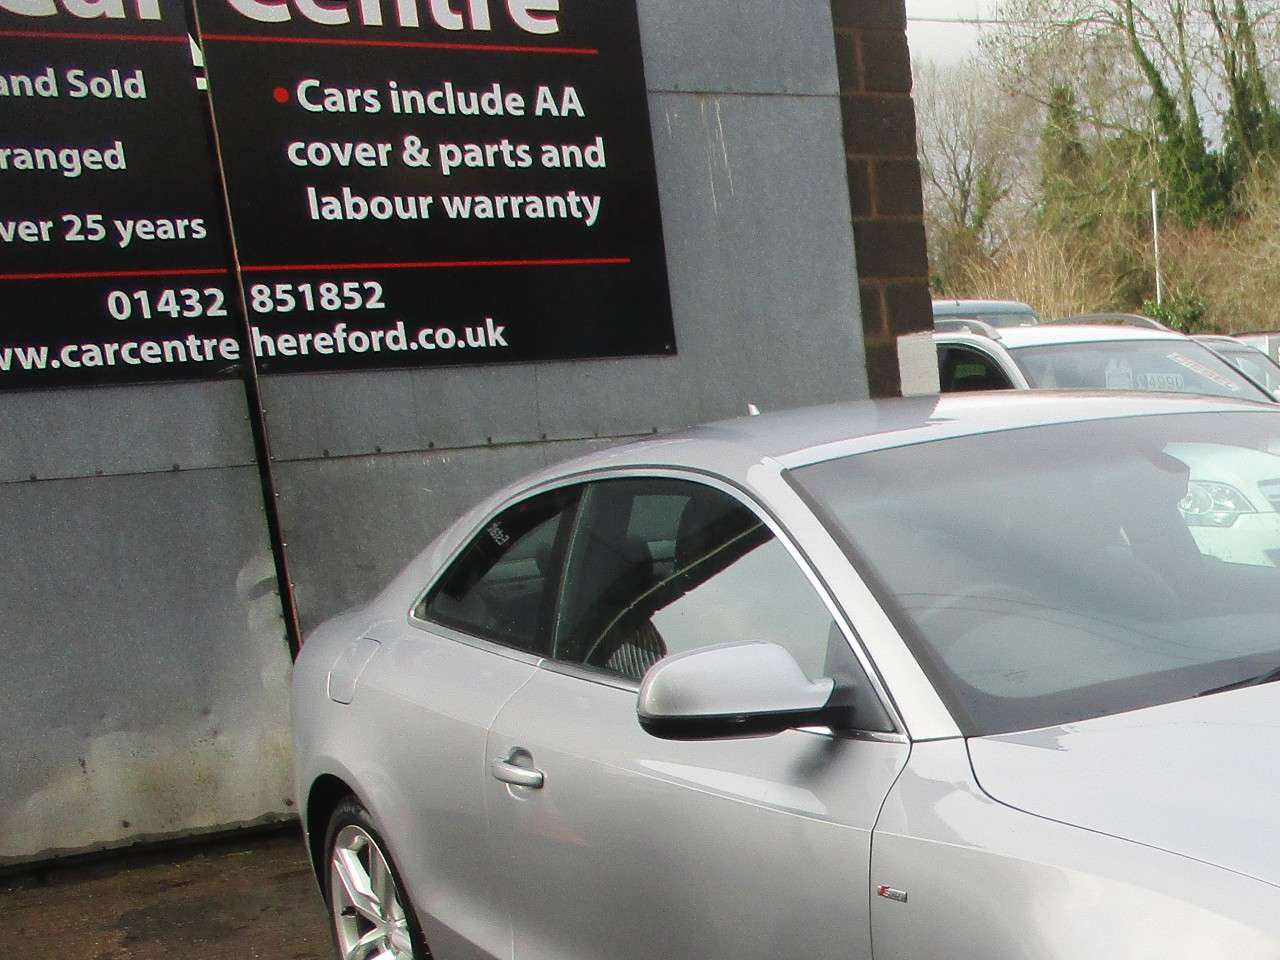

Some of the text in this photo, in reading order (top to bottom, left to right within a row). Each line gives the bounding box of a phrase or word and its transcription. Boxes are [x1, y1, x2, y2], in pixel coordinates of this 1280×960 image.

[66, 68, 147, 99] Sold
[296, 78, 586, 118] Cars include AA
[287, 135, 607, 176] cover & parts and
[306, 186, 602, 227] labour warranty
[61, 213, 107, 242] 25
[113, 218, 207, 249] years
[107, 281, 386, 322] 01432 851852
